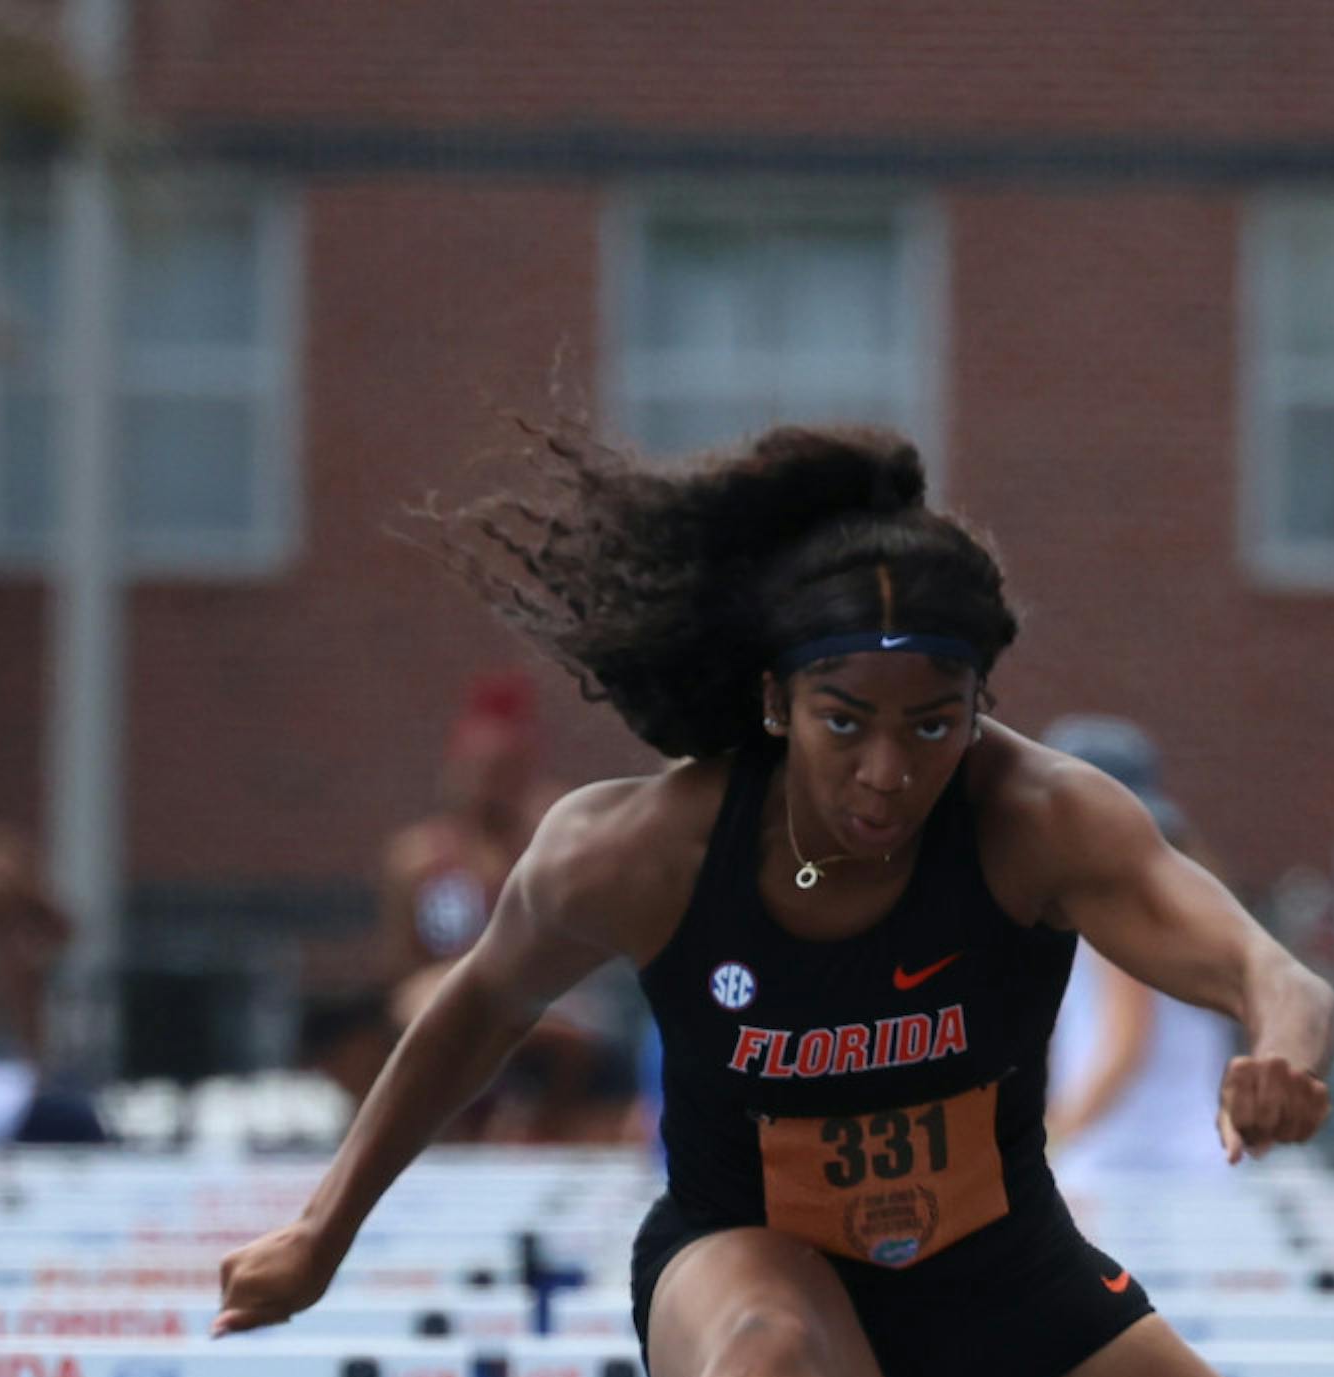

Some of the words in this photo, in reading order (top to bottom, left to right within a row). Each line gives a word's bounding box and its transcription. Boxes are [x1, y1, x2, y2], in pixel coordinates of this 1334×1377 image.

[711, 964, 755, 1008] SEC
[728, 1003, 967, 1079] FLORIDA
[821, 1104, 948, 1188] 331
